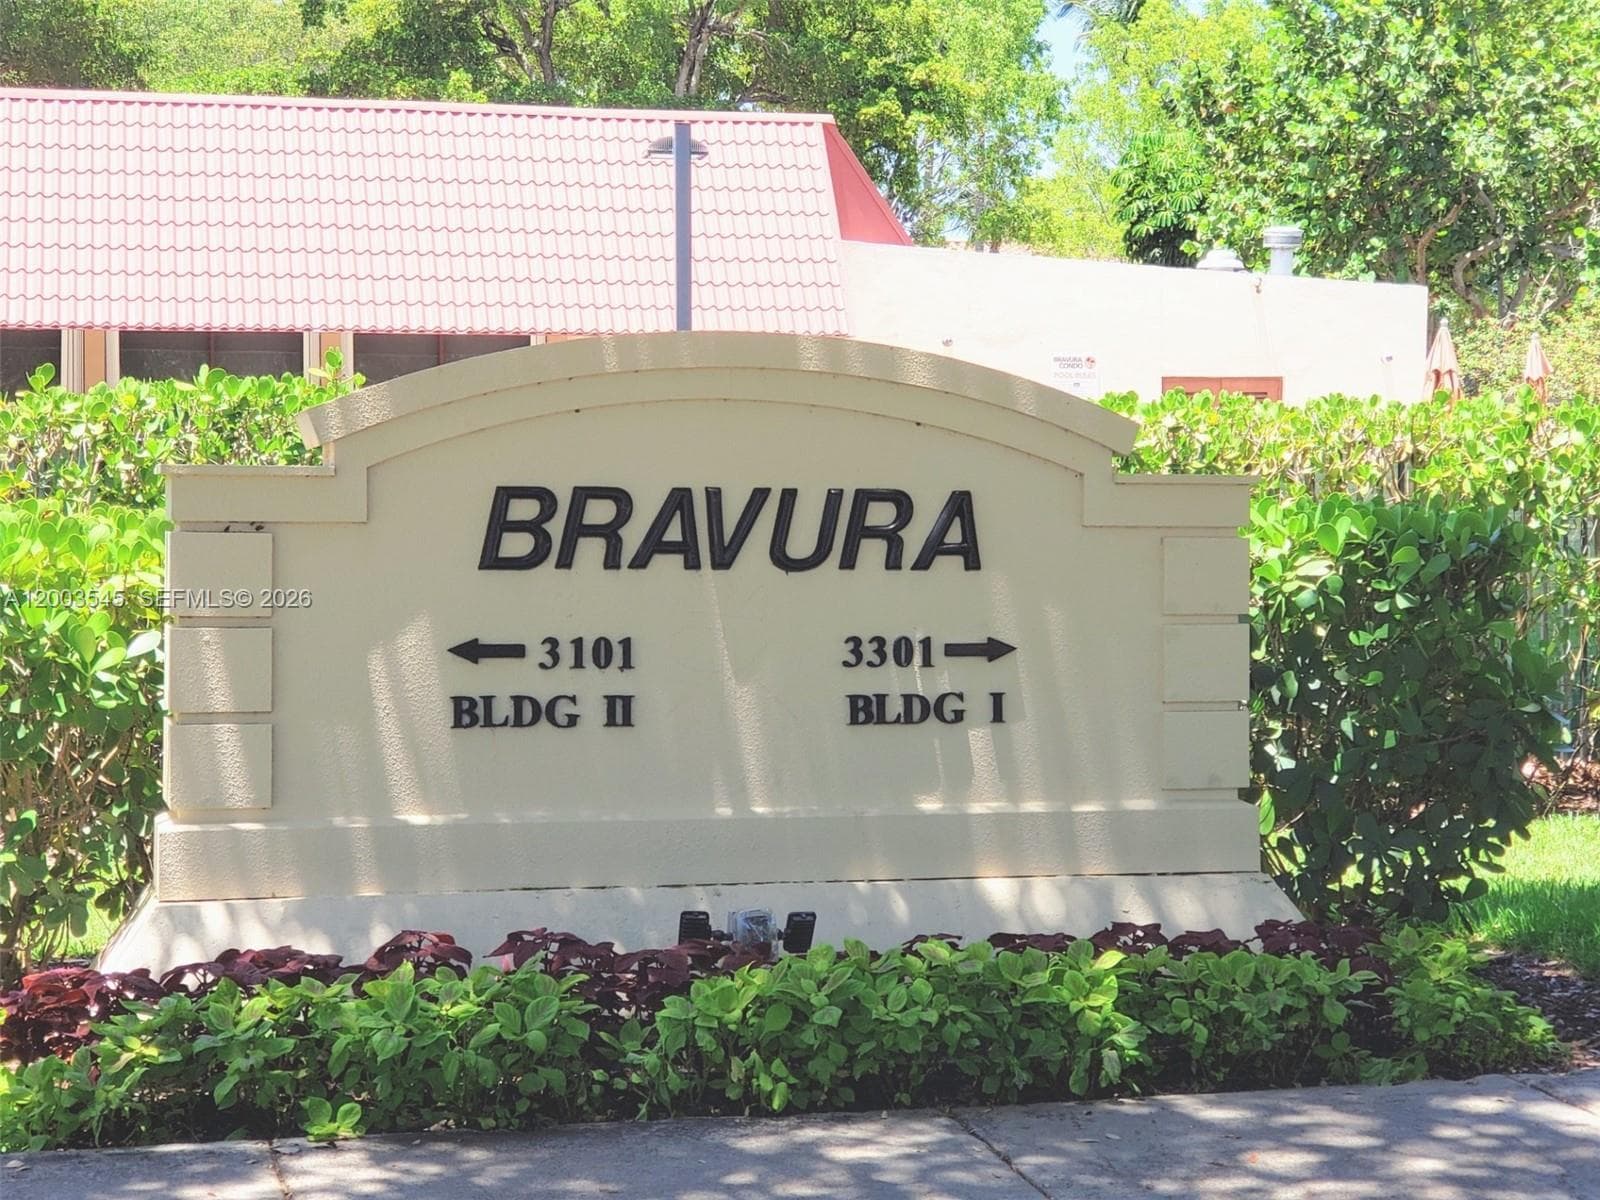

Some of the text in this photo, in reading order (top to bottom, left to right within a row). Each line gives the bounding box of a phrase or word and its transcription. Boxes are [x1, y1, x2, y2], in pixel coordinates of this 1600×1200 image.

[478, 486, 982, 572] BRAVURA
[538, 636, 635, 672] 3101
[842, 635, 935, 669] 3301
[450, 694, 636, 729] BLDG II
[846, 692, 1006, 726] BLDG I
